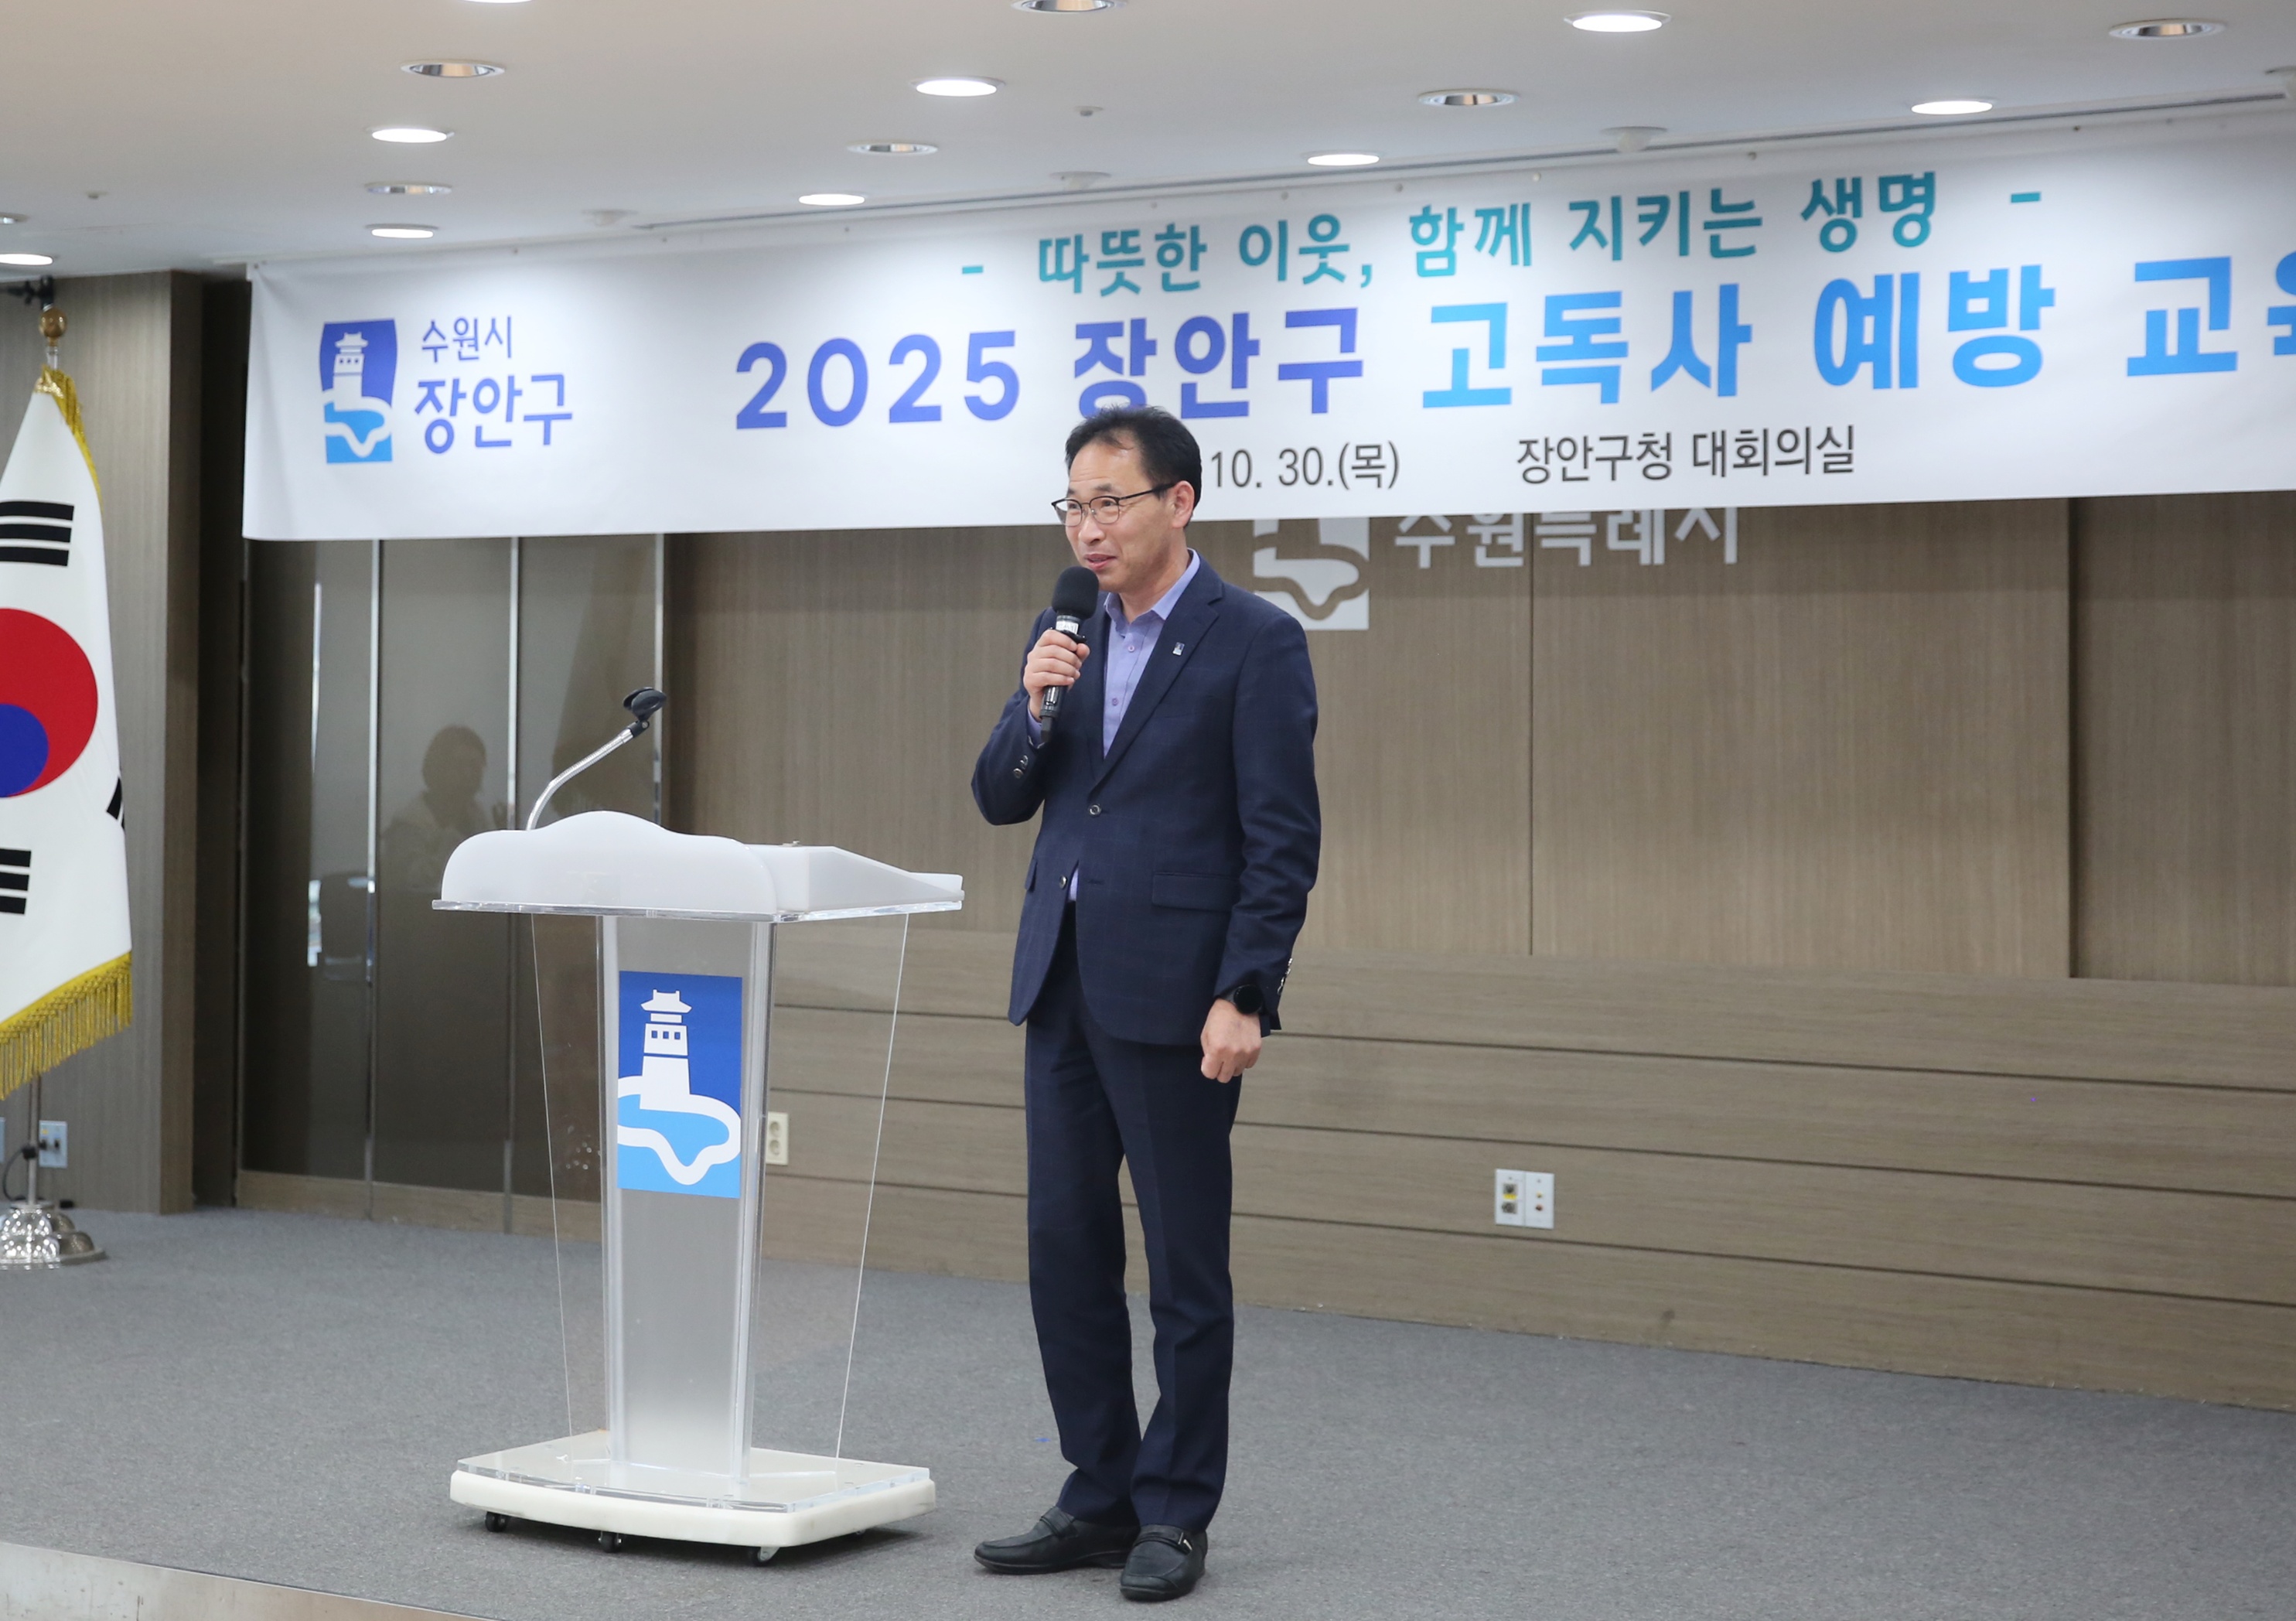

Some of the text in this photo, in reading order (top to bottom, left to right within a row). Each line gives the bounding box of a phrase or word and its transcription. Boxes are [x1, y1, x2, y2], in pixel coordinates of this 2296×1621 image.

[1039, 223, 1207, 297] 따뜻한
[1239, 213, 1373, 288] 이웃,
[1409, 203, 1532, 277] 함께
[1568, 188, 1762, 261] 지키는
[1801, 171, 1936, 253] 생명
[421, 316, 513, 363] 수원시
[736, 251, 2296, 429] 2025 장안구 고독사 예방 교
[415, 374, 573, 454] 장안구
[1211, 425, 1855, 490] 10. 30.(목) 장안구청 대회의실
